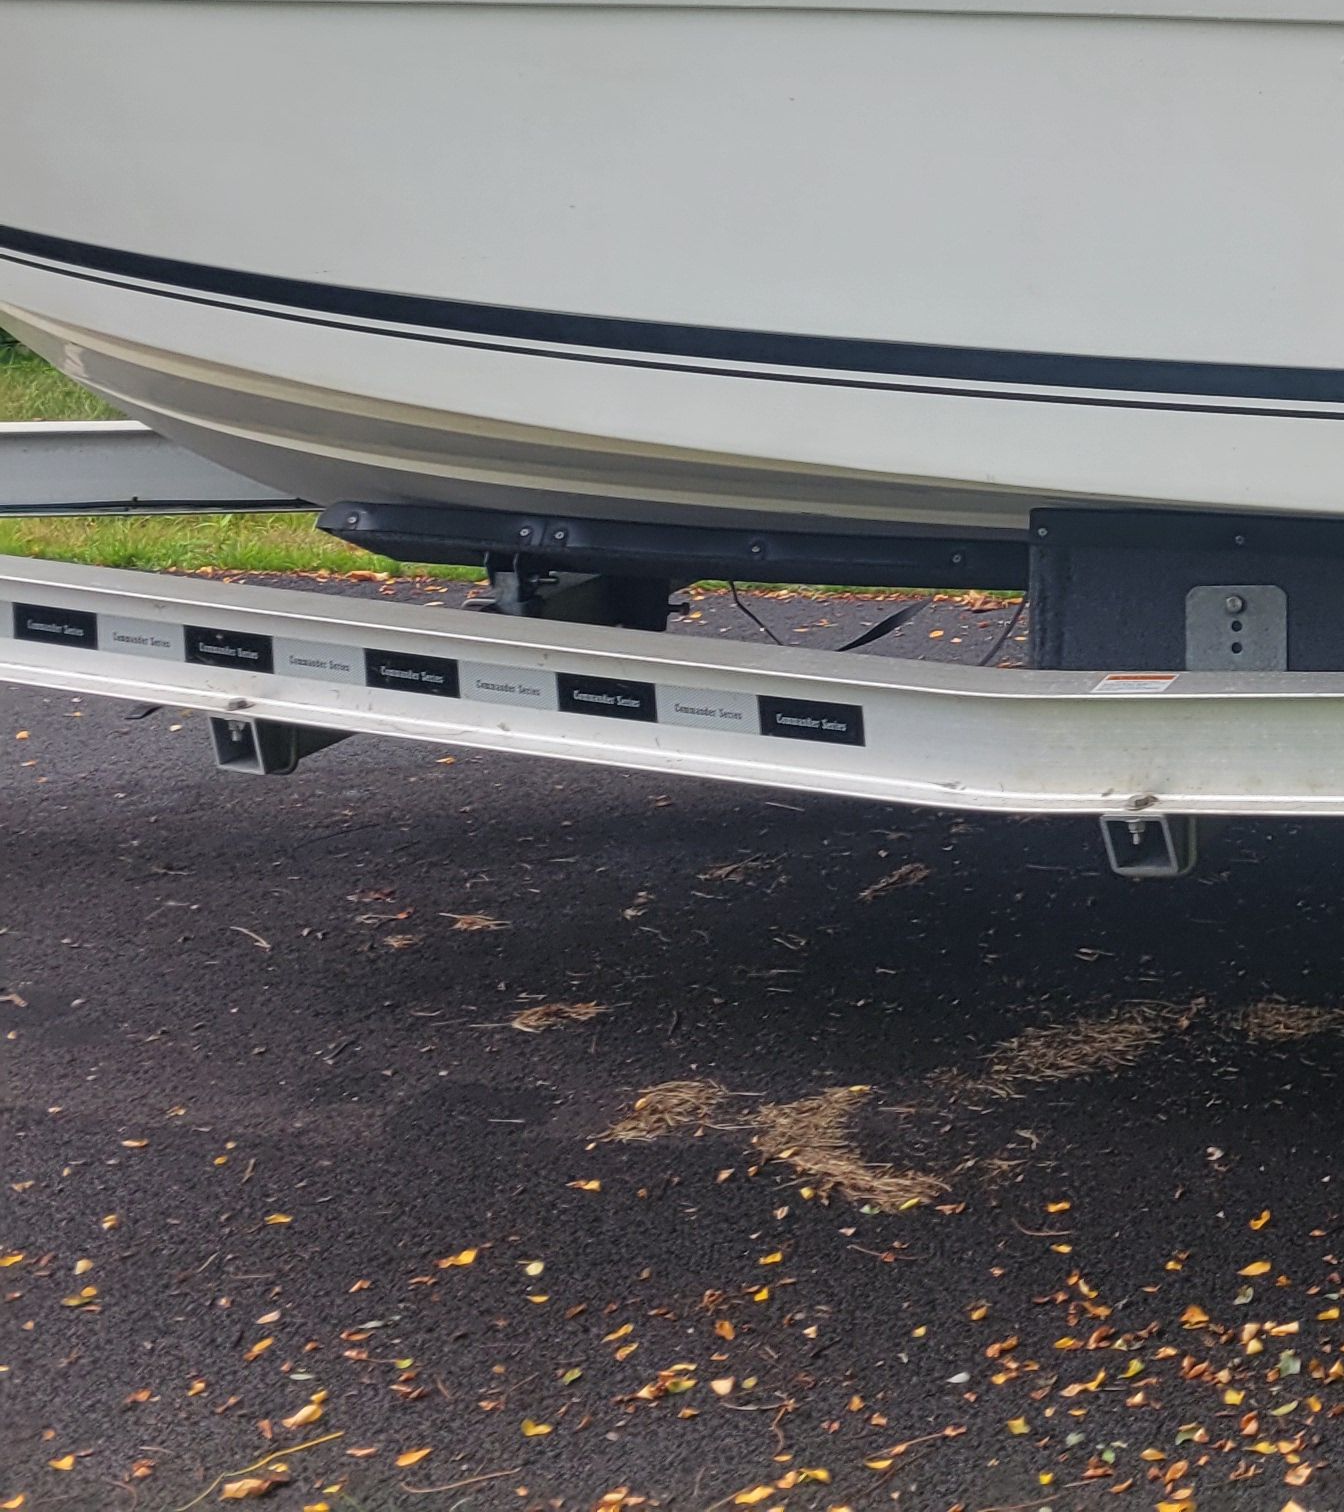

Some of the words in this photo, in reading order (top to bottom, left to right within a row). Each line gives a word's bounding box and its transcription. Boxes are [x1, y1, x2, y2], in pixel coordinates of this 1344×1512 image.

[288, 655, 328, 669] Commander
[328, 660, 350, 673] Series
[380, 665, 420, 681] Commander
[421, 671, 445, 684] Series
[475, 679, 516, 694] Commander
[517, 684, 541, 697] Series
[573, 689, 615, 705] Commander
[616, 695, 641, 708] Series
[674, 703, 717, 718] Commander
[718, 707, 743, 720] Series
[776, 712, 820, 729] Commander
[821, 718, 848, 732] Series
